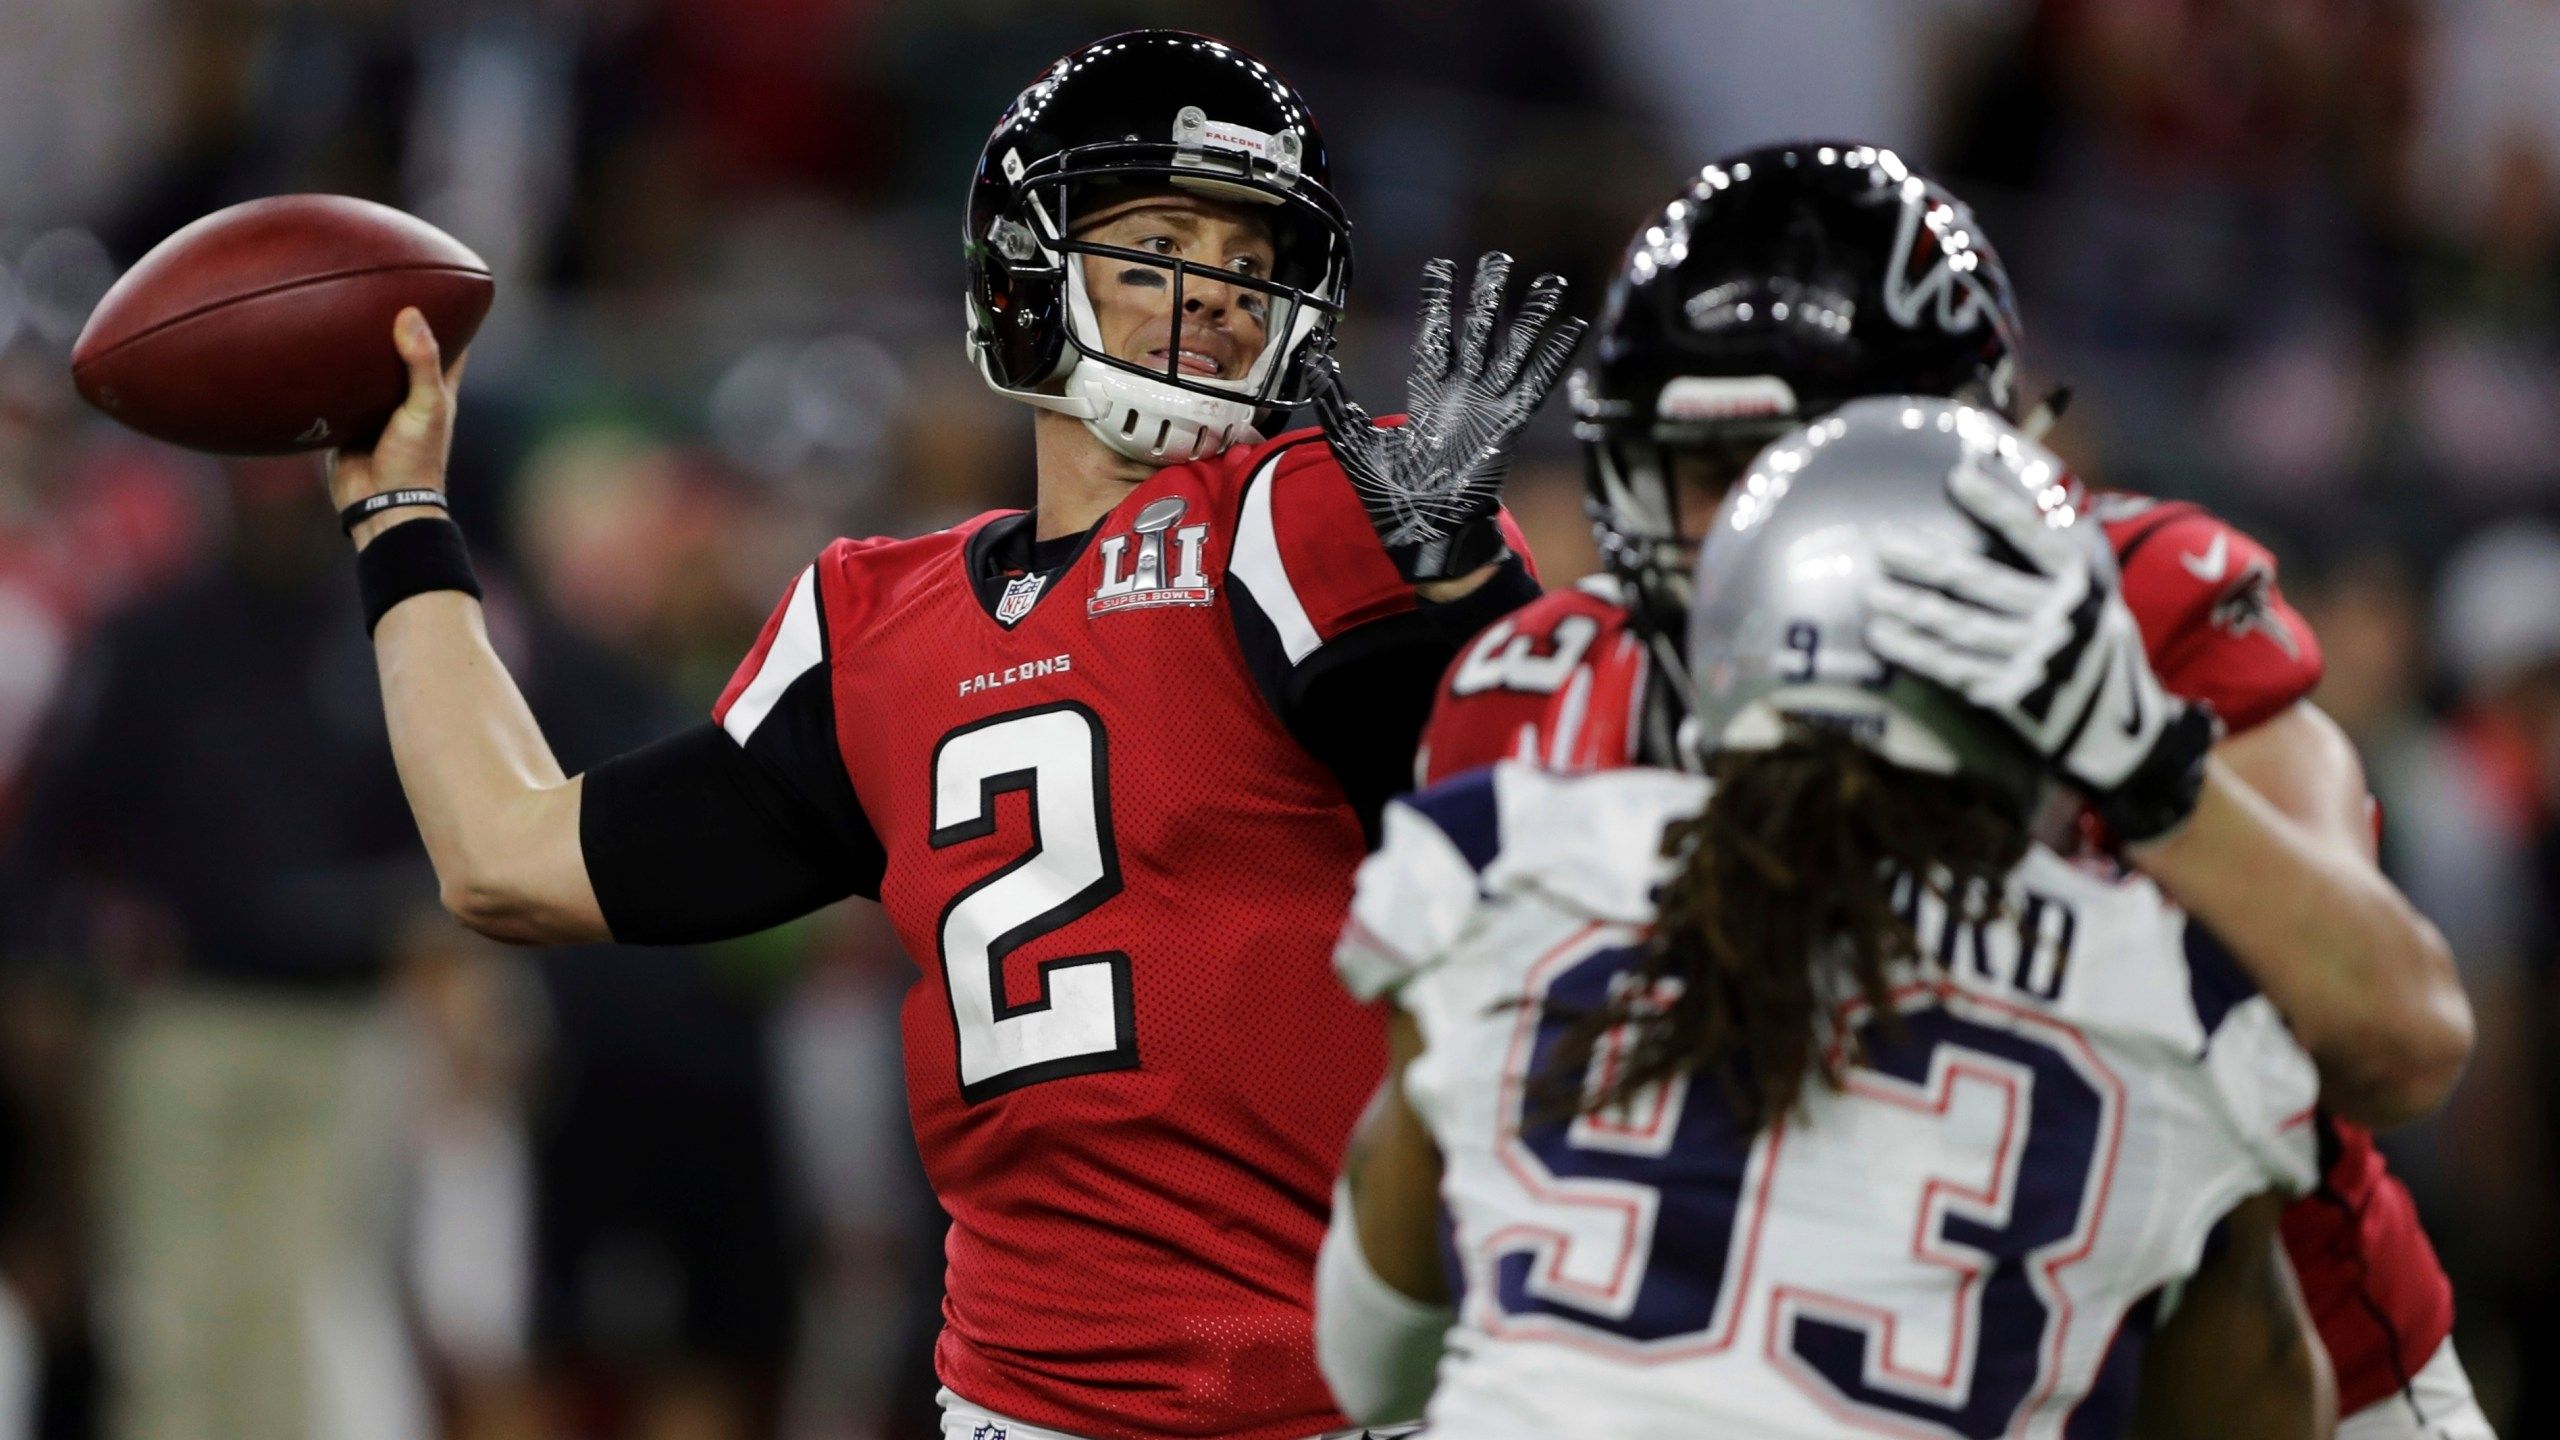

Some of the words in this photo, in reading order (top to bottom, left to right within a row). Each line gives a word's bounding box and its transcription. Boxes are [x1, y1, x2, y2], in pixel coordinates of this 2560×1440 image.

[1205, 131, 1263, 150] FALCONS
[1001, 593, 1034, 616] NFL
[1102, 593, 1147, 609] SUPER
[1151, 590, 1193, 601] BOWL
[958, 653, 1072, 698] FALCONS
[930, 699, 1140, 1105] 2
[1483, 920, 2126, 1440] 93
